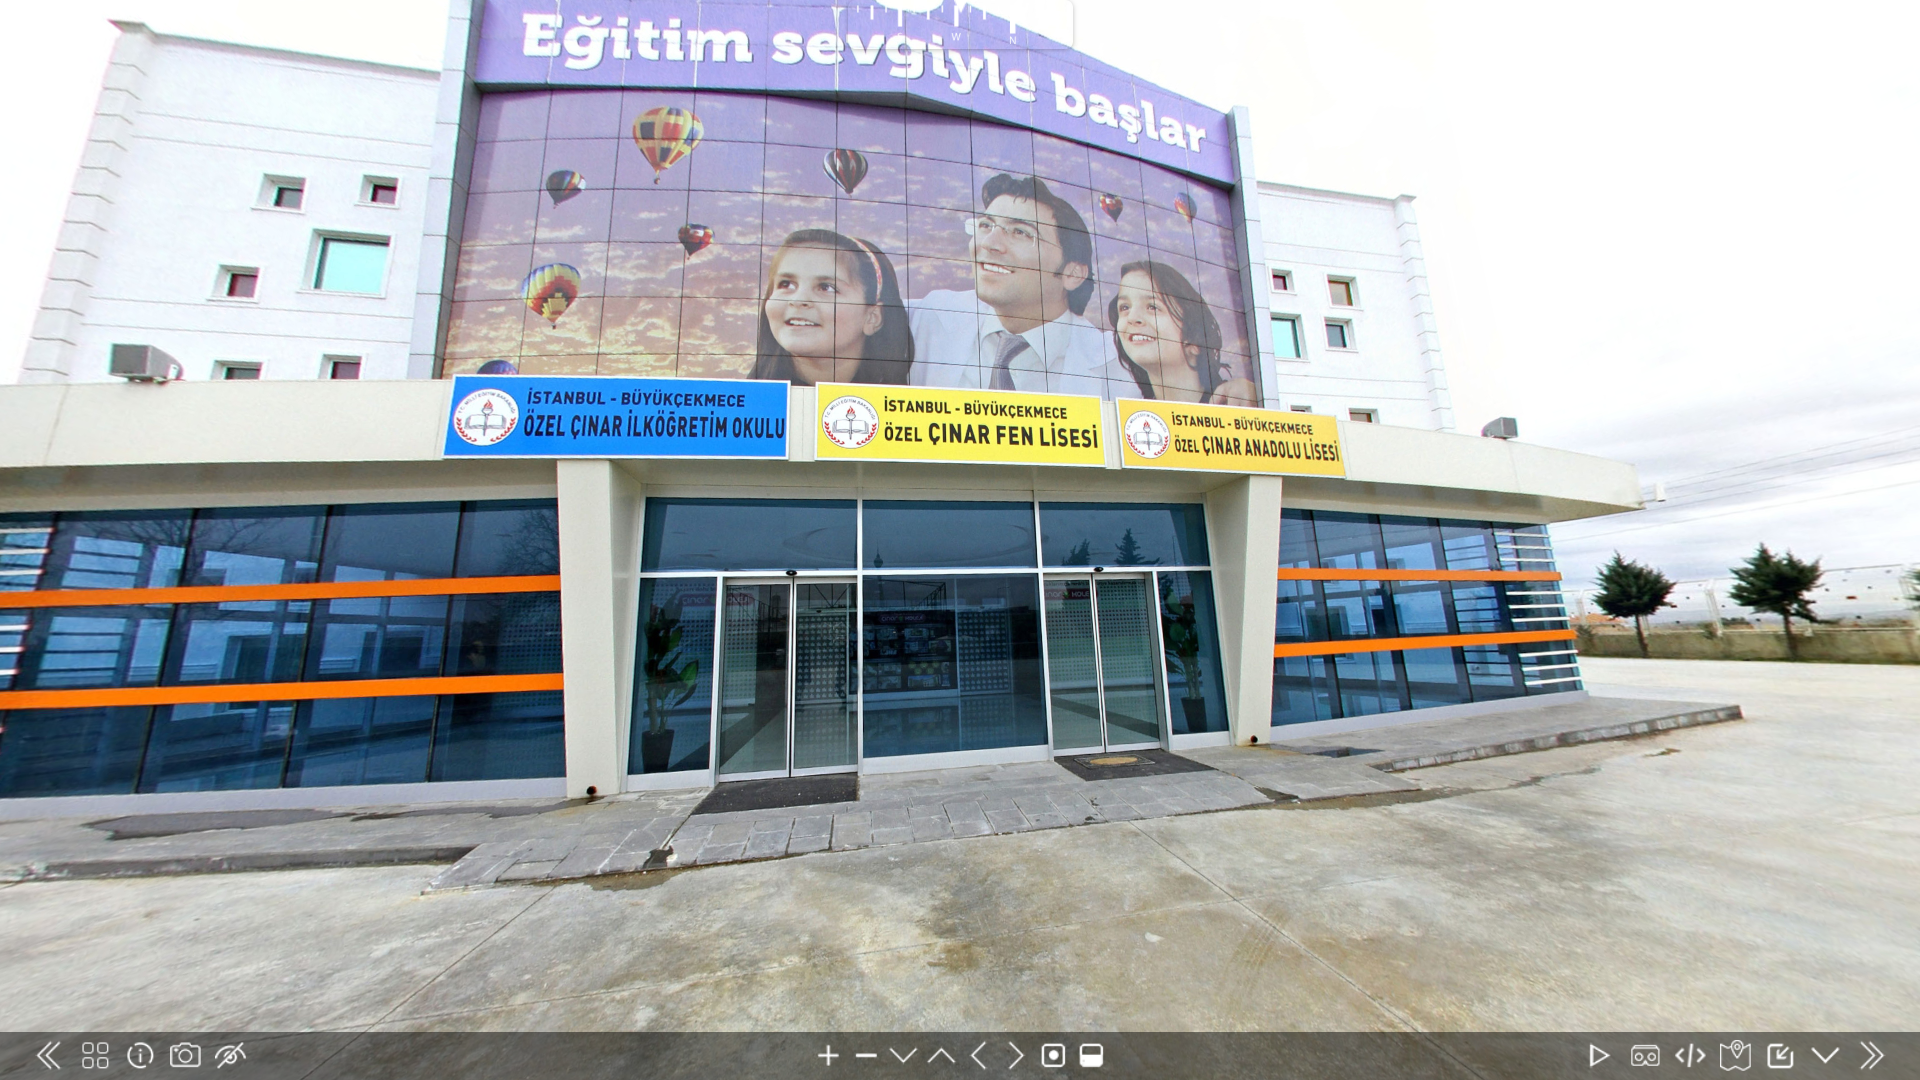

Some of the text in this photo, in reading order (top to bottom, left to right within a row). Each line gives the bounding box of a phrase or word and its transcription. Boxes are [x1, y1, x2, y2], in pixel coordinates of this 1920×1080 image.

[523, 13, 1207, 153] Eğitim sevgiyle başlar
[527, 387, 606, 405] İSTANBUL
[621, 388, 745, 408] BÜYÜKÇEKMECE
[884, 395, 952, 414] İSTANBUL
[964, 399, 1068, 420] BÜYÜKÇEKMECE
[523, 408, 785, 440] ÖZEL ÇINAR İLKÖĞRETİM OKULU
[884, 421, 1099, 449] ÖZEL ÇINAR FEN LİSESİ
[1171, 411, 1226, 429] İSTANBUL
[1234, 416, 1314, 436] BÜYÜKÇEKMECE
[1174, 434, 1340, 463] ÖZEL ÇINAR ANADOLU LİSESİ
